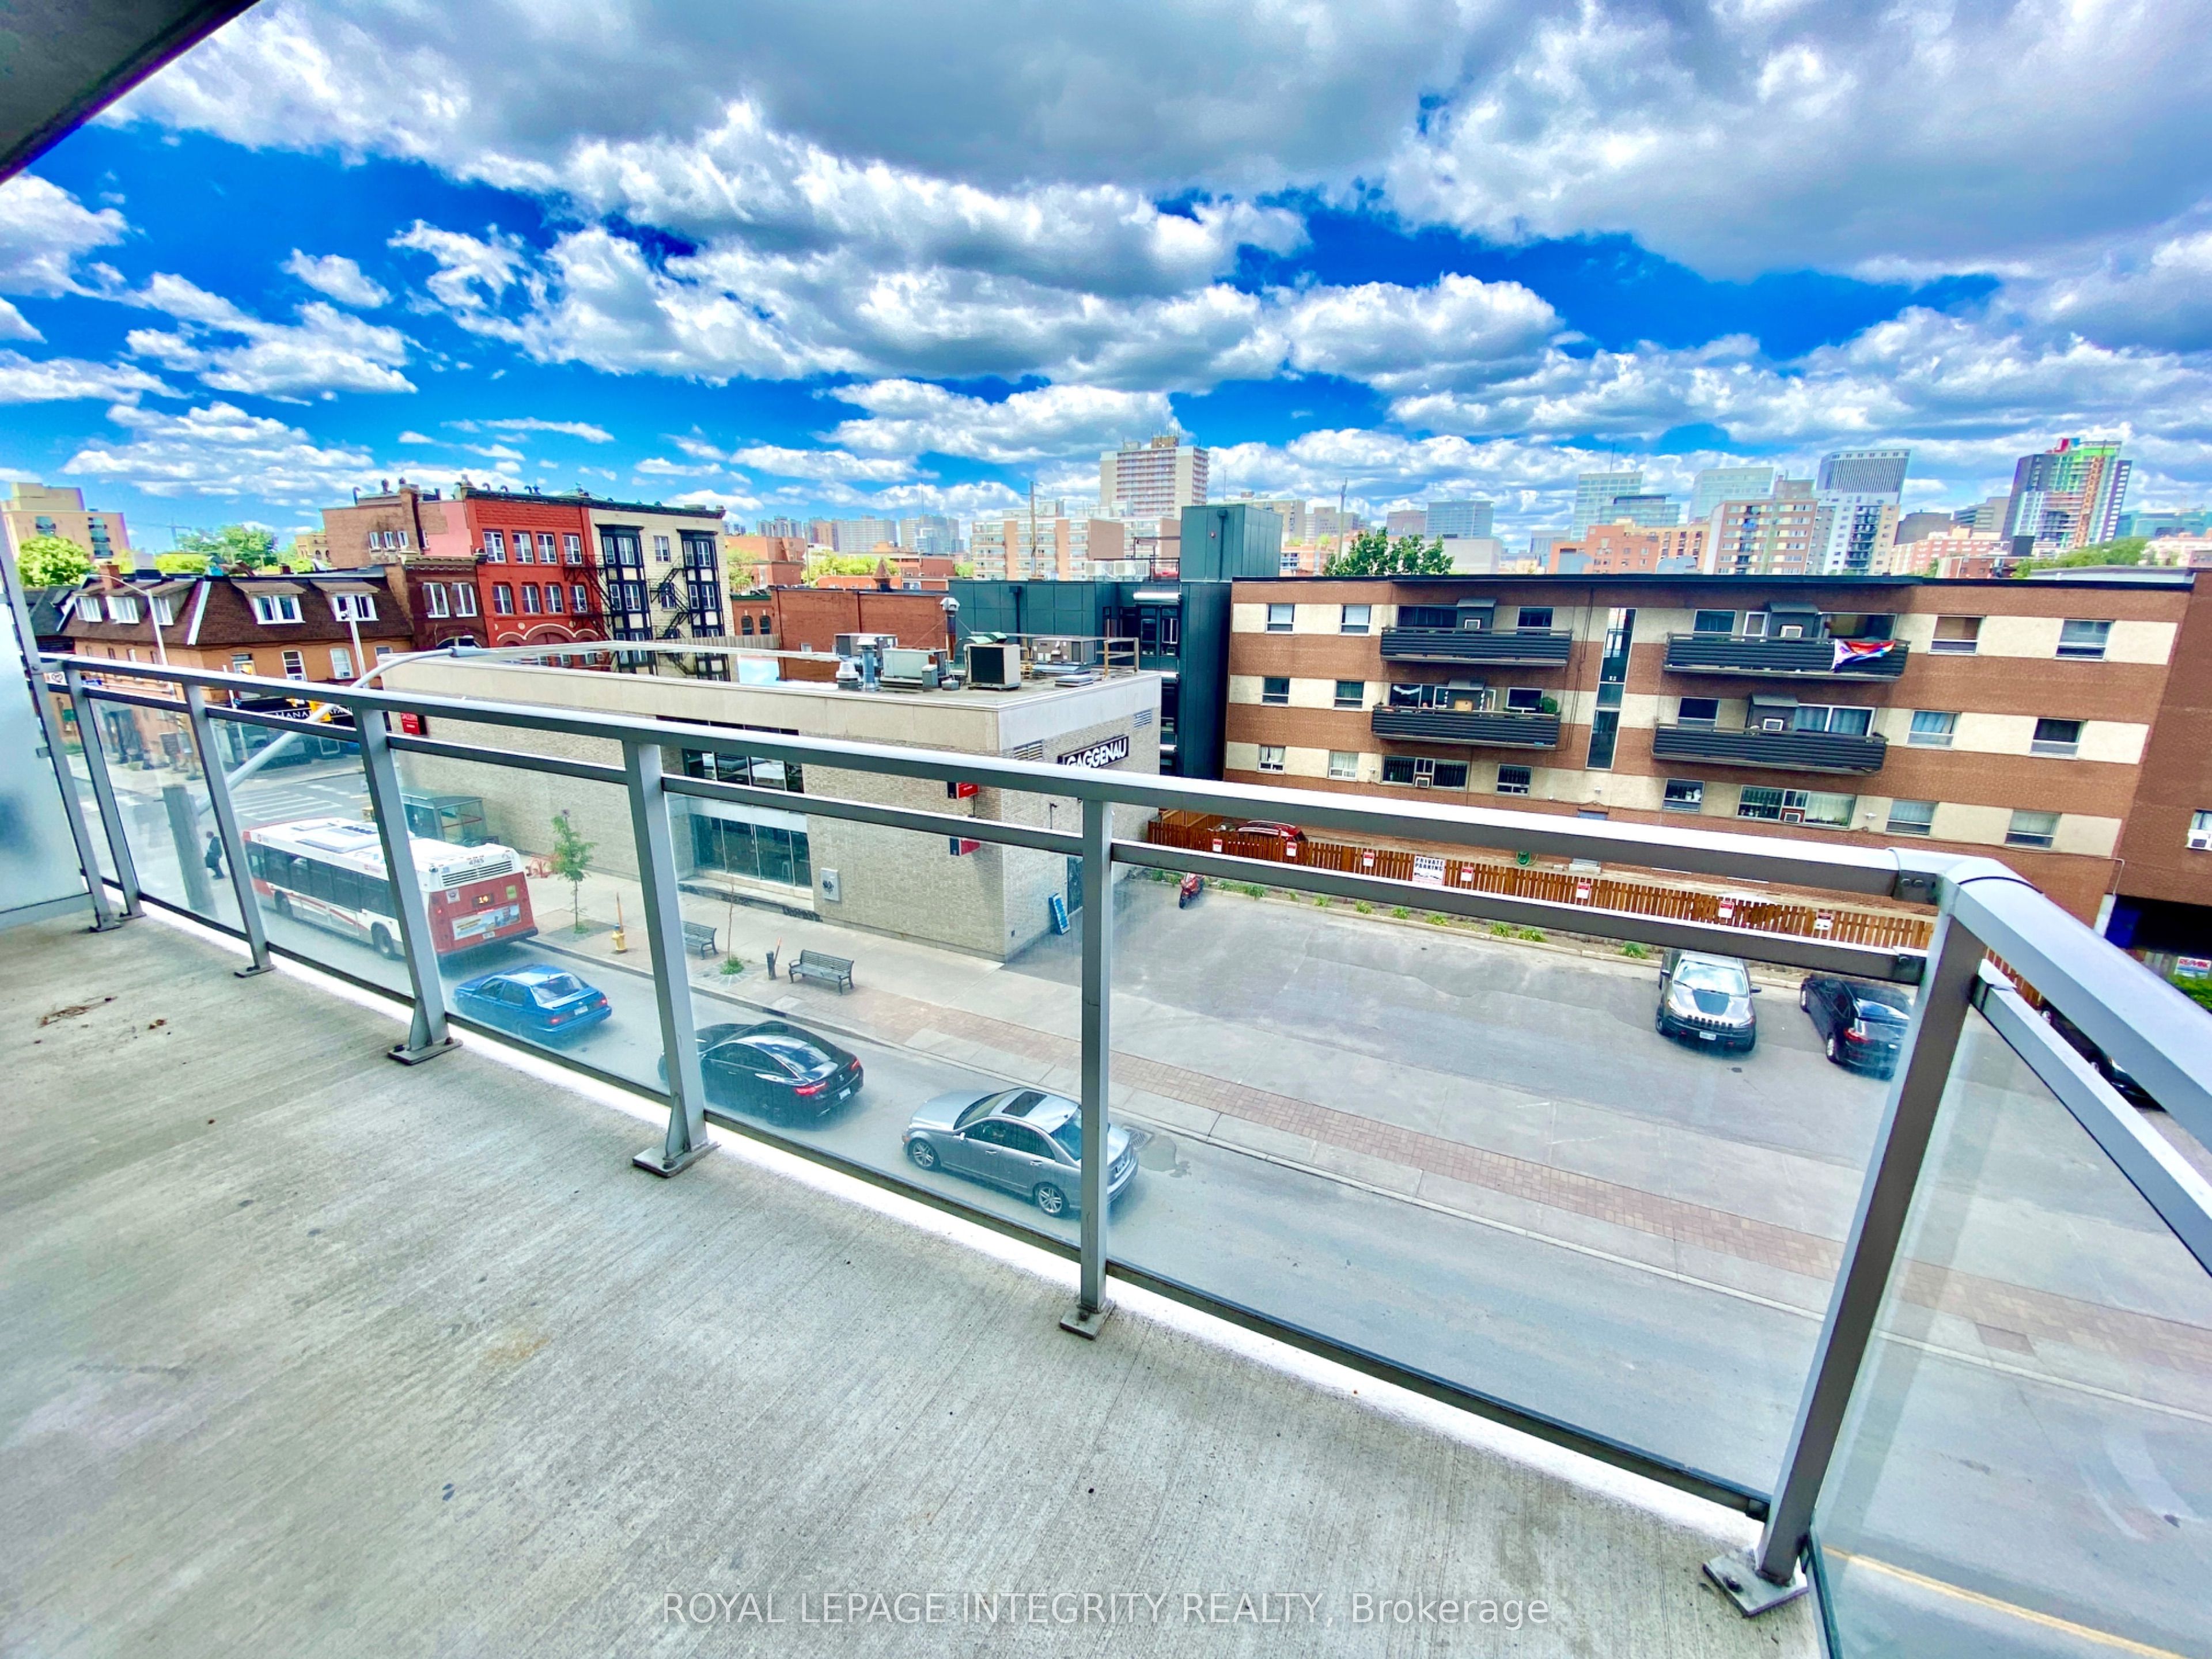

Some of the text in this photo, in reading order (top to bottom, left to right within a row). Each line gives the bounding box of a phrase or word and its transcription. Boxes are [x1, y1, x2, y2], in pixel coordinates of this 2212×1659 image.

[1066, 738, 1127, 767] GAGGENAU
[1416, 858, 1443, 866] PRIVATE
[1415, 863, 1443, 871] PARKING
